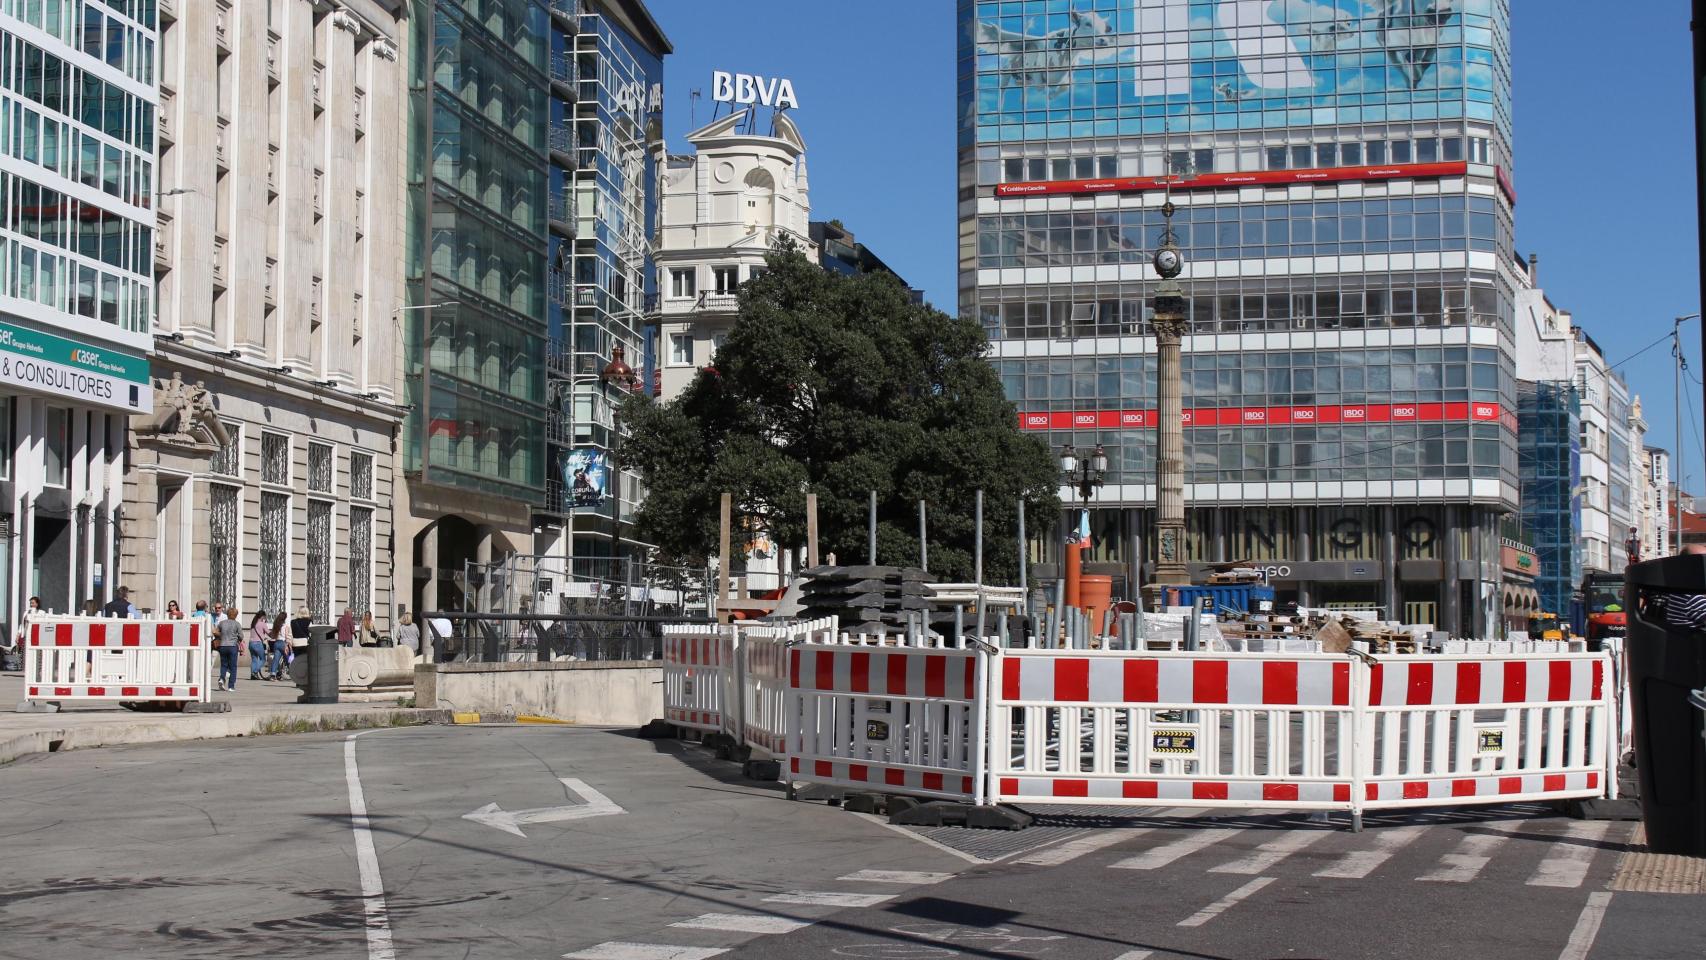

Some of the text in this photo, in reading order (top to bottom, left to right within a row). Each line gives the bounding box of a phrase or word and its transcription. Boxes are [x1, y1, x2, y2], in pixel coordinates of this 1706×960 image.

[712, 70, 799, 109] BBVA
[76, 348, 100, 367] caser
[3, 357, 112, 399] & CONSULTORES
[1245, 412, 1264, 420] BDO
[1294, 411, 1314, 420] BDO
[1344, 410, 1364, 418] BDO
[1394, 408, 1414, 417] BDO
[1029, 416, 1047, 424] BDO
[1076, 415, 1095, 423] BDO
[1124, 414, 1142, 422] BDO
